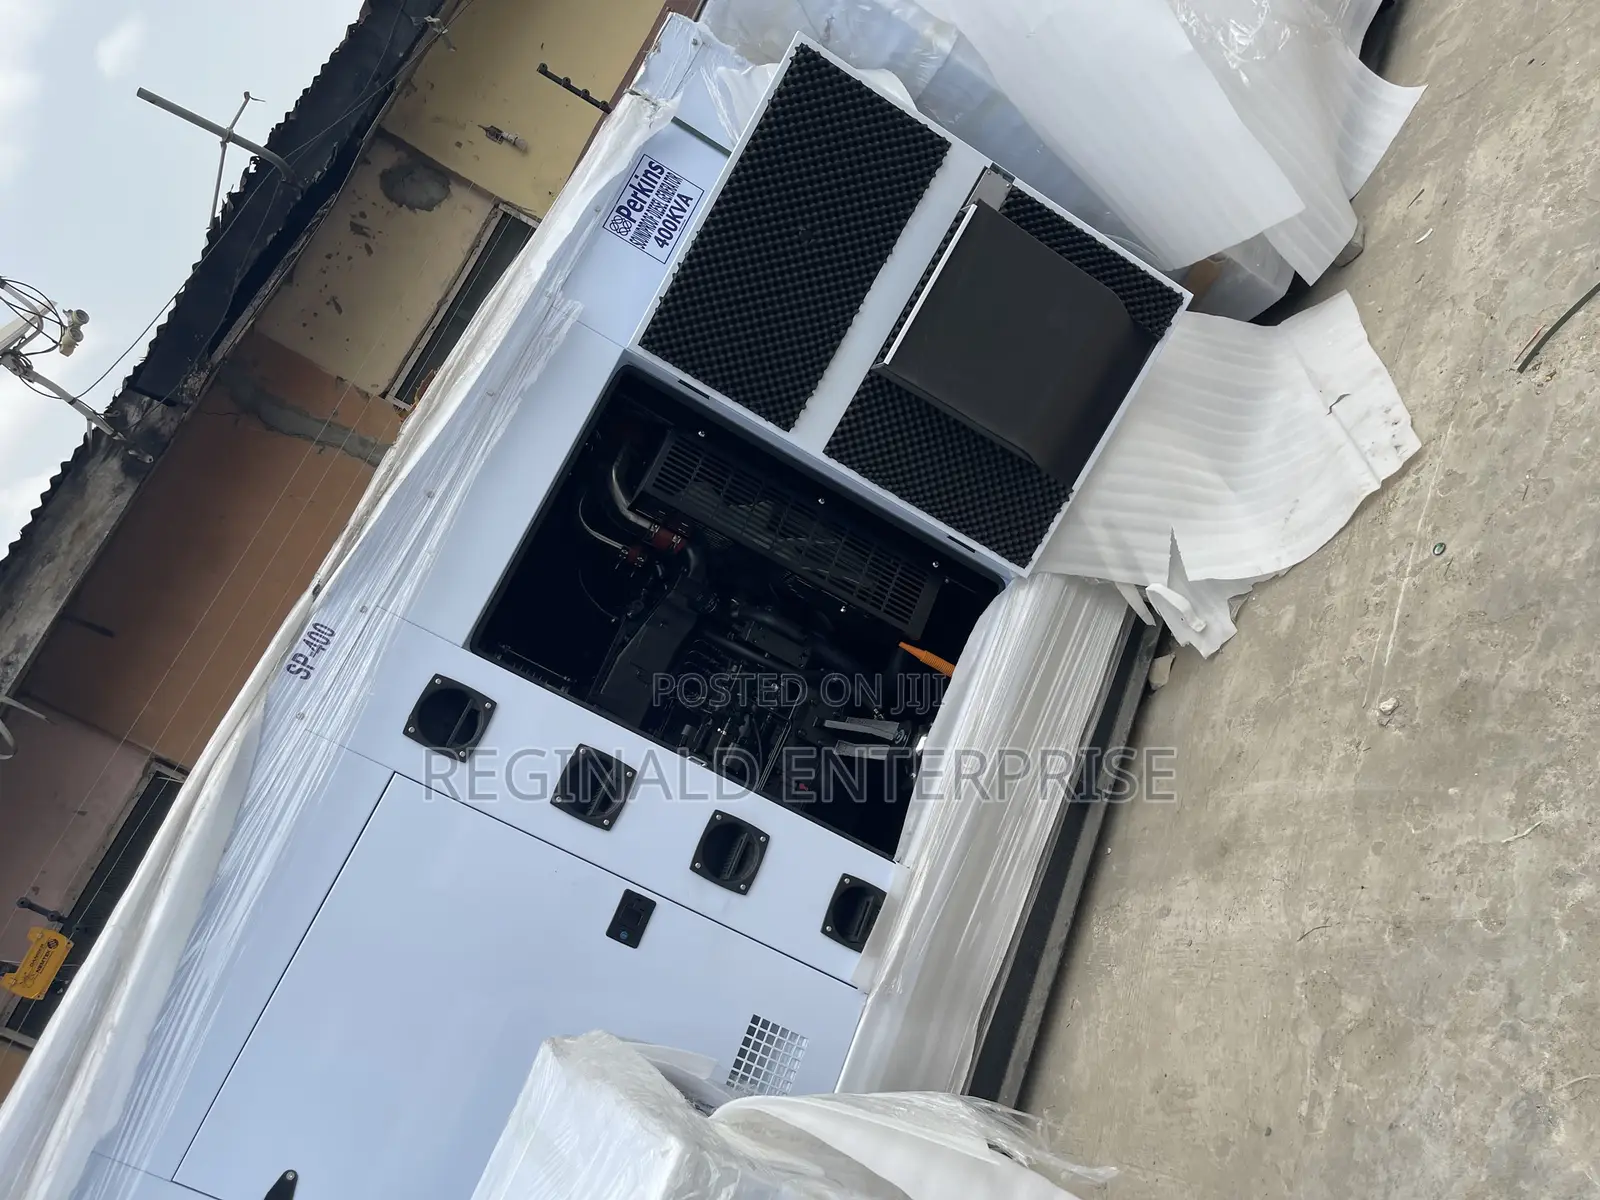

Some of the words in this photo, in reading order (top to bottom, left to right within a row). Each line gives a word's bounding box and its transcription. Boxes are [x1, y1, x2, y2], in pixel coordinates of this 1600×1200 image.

[616, 161, 665, 223] Perkins
[645, 197, 669, 220] DIESEL
[654, 171, 683, 204] GENERATOR
[629, 212, 660, 250] SOUNDPROOF
[653, 193, 694, 248] 400KVA
[286, 622, 335, 680] SP-400
